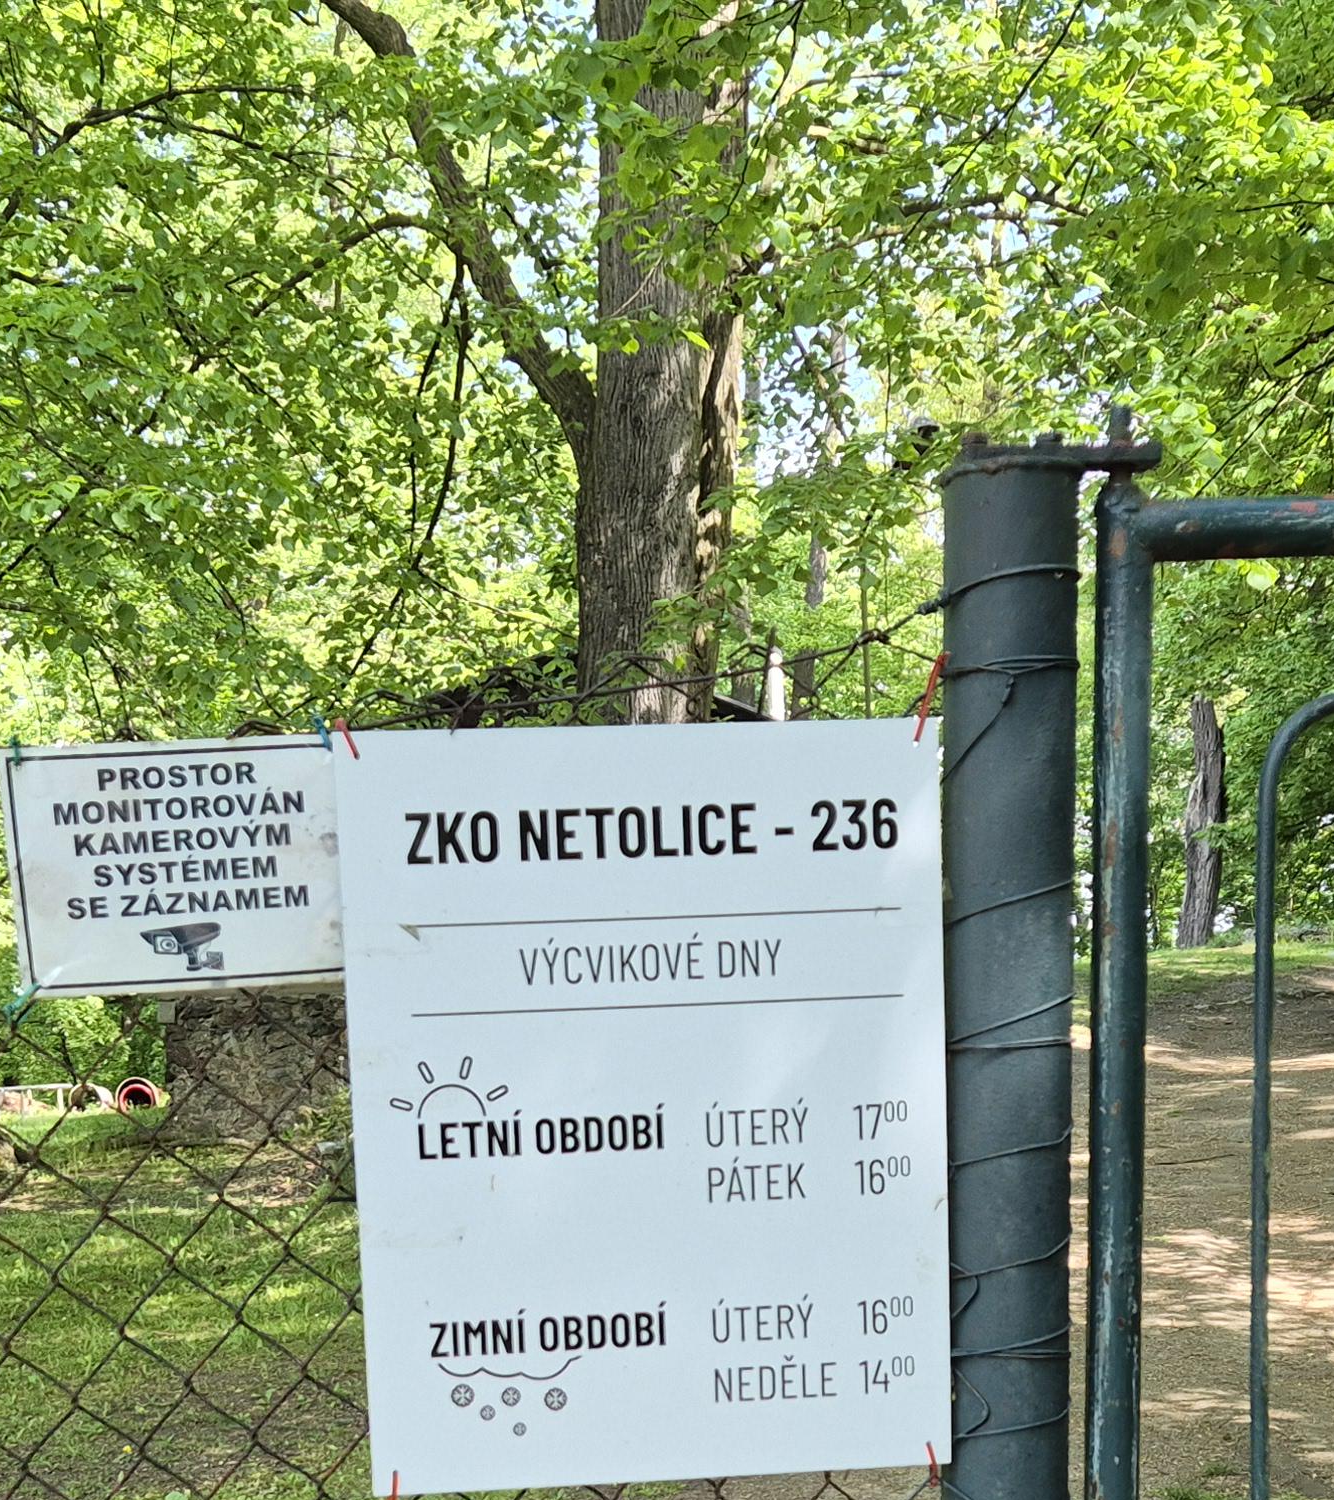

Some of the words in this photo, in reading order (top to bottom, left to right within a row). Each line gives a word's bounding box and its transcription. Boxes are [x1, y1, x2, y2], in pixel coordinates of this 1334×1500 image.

[97, 762, 256, 791] PROSTOR
[53, 787, 305, 826] MONITOROVÁN
[74, 819, 291, 857] KAMEROVÝM
[405, 810, 498, 865] ZKO
[520, 803, 758, 862] NETOLICE
[810, 798, 898, 853] 236
[94, 855, 278, 888] SYSTÉMEM
[67, 896, 109, 920] SE
[120, 884, 309, 918] ZÁZNAMEM
[520, 932, 704, 986] VÝCVIKOVÉ
[719, 939, 781, 979] DNY
[417, 1111, 522, 1161] LETNÍ
[535, 1103, 665, 1154] OBDOBÍ
[706, 1098, 809, 1148] ÚTERÝ
[707, 1158, 807, 1203] PÁTEK
[430, 1309, 525, 1358] ZIMNÍ
[539, 1302, 667, 1351] OBDOBÍ
[712, 1294, 813, 1343] ÚTERÝ
[713, 1355, 837, 1404] NEDĚLE
